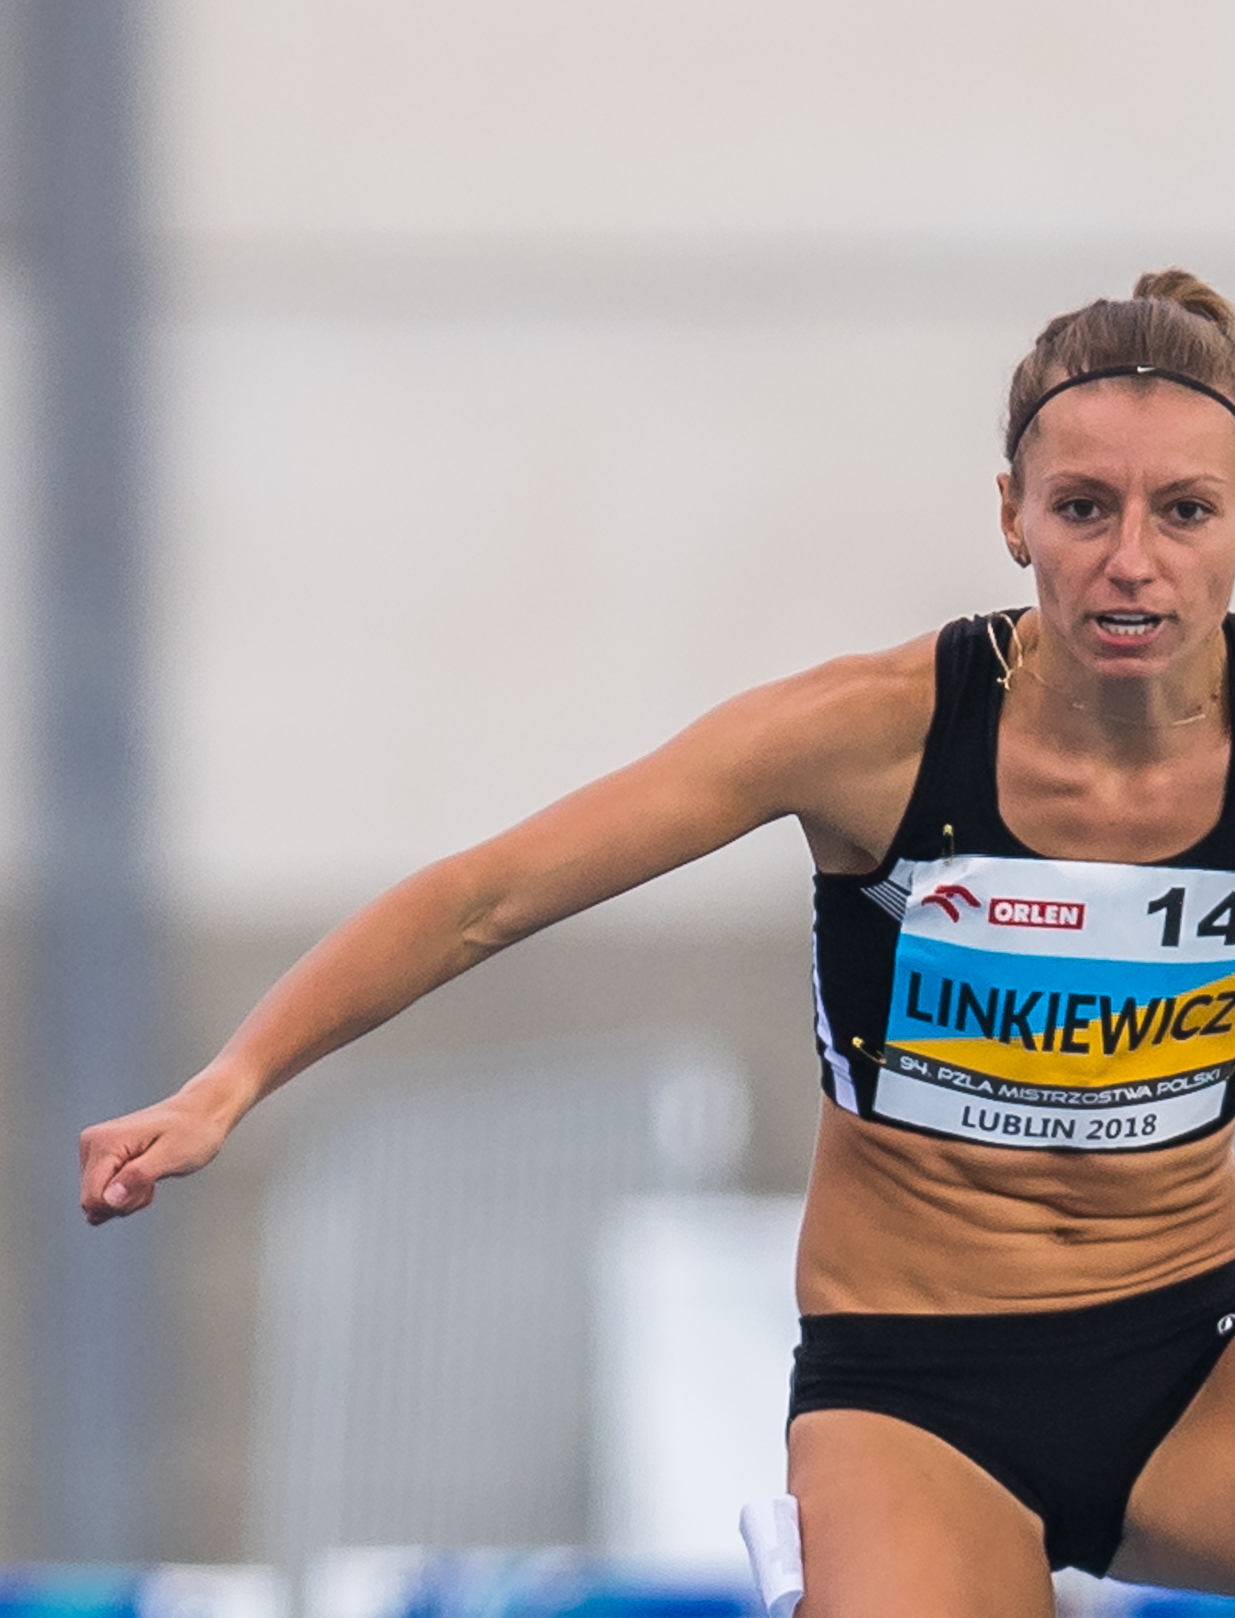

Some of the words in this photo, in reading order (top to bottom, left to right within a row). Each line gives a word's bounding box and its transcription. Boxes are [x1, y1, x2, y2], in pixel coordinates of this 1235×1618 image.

[994, 900, 1079, 926] ORLEN
[937, 1063, 994, 1094] PZLA
[998, 1083, 1152, 1105] MISTRZOSTWA
[1156, 1067, 1222, 1096] POLSKI
[961, 1105, 1076, 1139] LUBLIN
[1085, 1113, 1158, 1141] 2018
